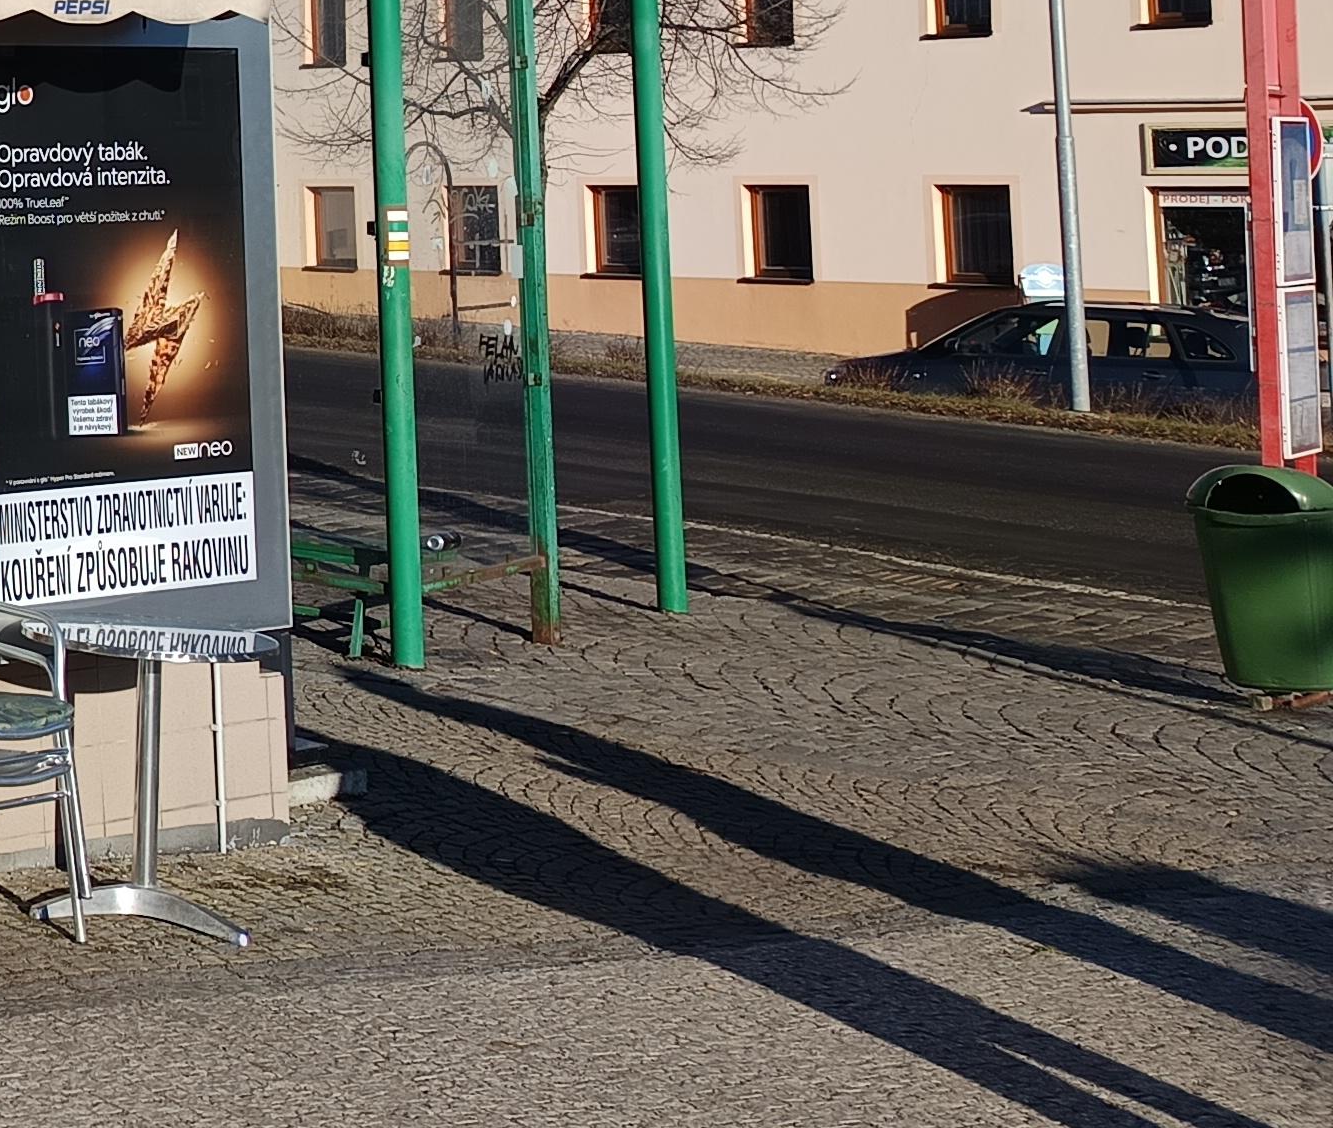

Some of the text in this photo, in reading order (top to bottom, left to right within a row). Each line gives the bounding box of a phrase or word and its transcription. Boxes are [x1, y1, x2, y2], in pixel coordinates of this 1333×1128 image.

[54, 0, 110, 15] PEPSI
[97, 141, 148, 161] tabák.
[1186, 136, 1249, 159] POD
[97, 166, 170, 186] intenzita.
[1162, 194, 1210, 204] PRODEJ
[27, 213, 55, 225] Boost
[56, 215, 73, 226] pro
[74, 211, 97, 223] větší
[98, 210, 131, 225] požitek
[131, 213, 138, 221] z
[78, 335, 101, 348] neo
[176, 440, 233, 458] NEW neo
[0, 478, 247, 545] MINISTERSTVO ZDRAVOTNICTVÍ VARUJE:
[1, 534, 249, 602] KOUŘENÍ ZPŮSOBUJE RAKOVINU
